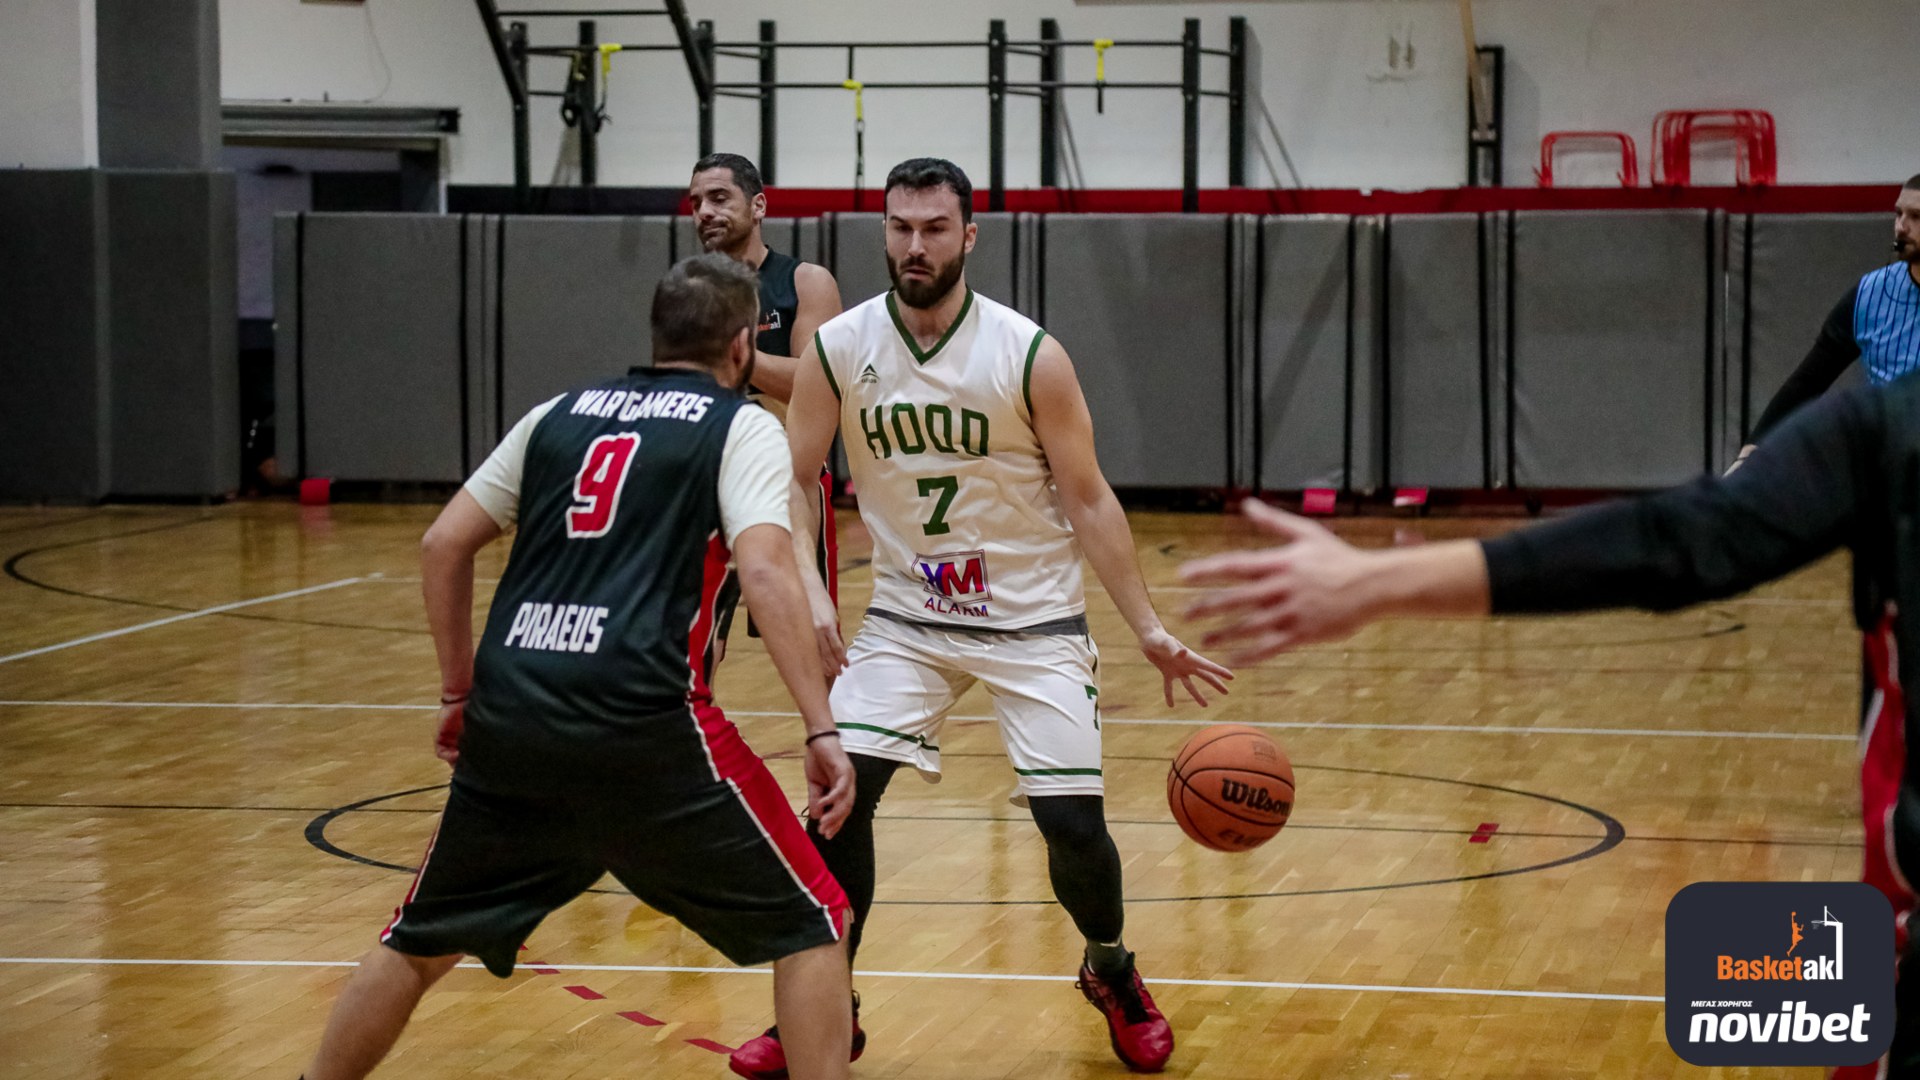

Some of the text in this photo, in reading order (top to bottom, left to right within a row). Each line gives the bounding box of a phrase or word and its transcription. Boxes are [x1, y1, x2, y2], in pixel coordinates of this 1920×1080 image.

[570, 389, 714, 422] WARGAMERS
[860, 402, 989, 459] HOOD
[565, 431, 641, 539] 9
[916, 475, 959, 537] 7
[504, 602, 609, 653] PIRAEUS
[924, 596, 989, 617] ALARM
[1222, 778, 1291, 817] Wilson
